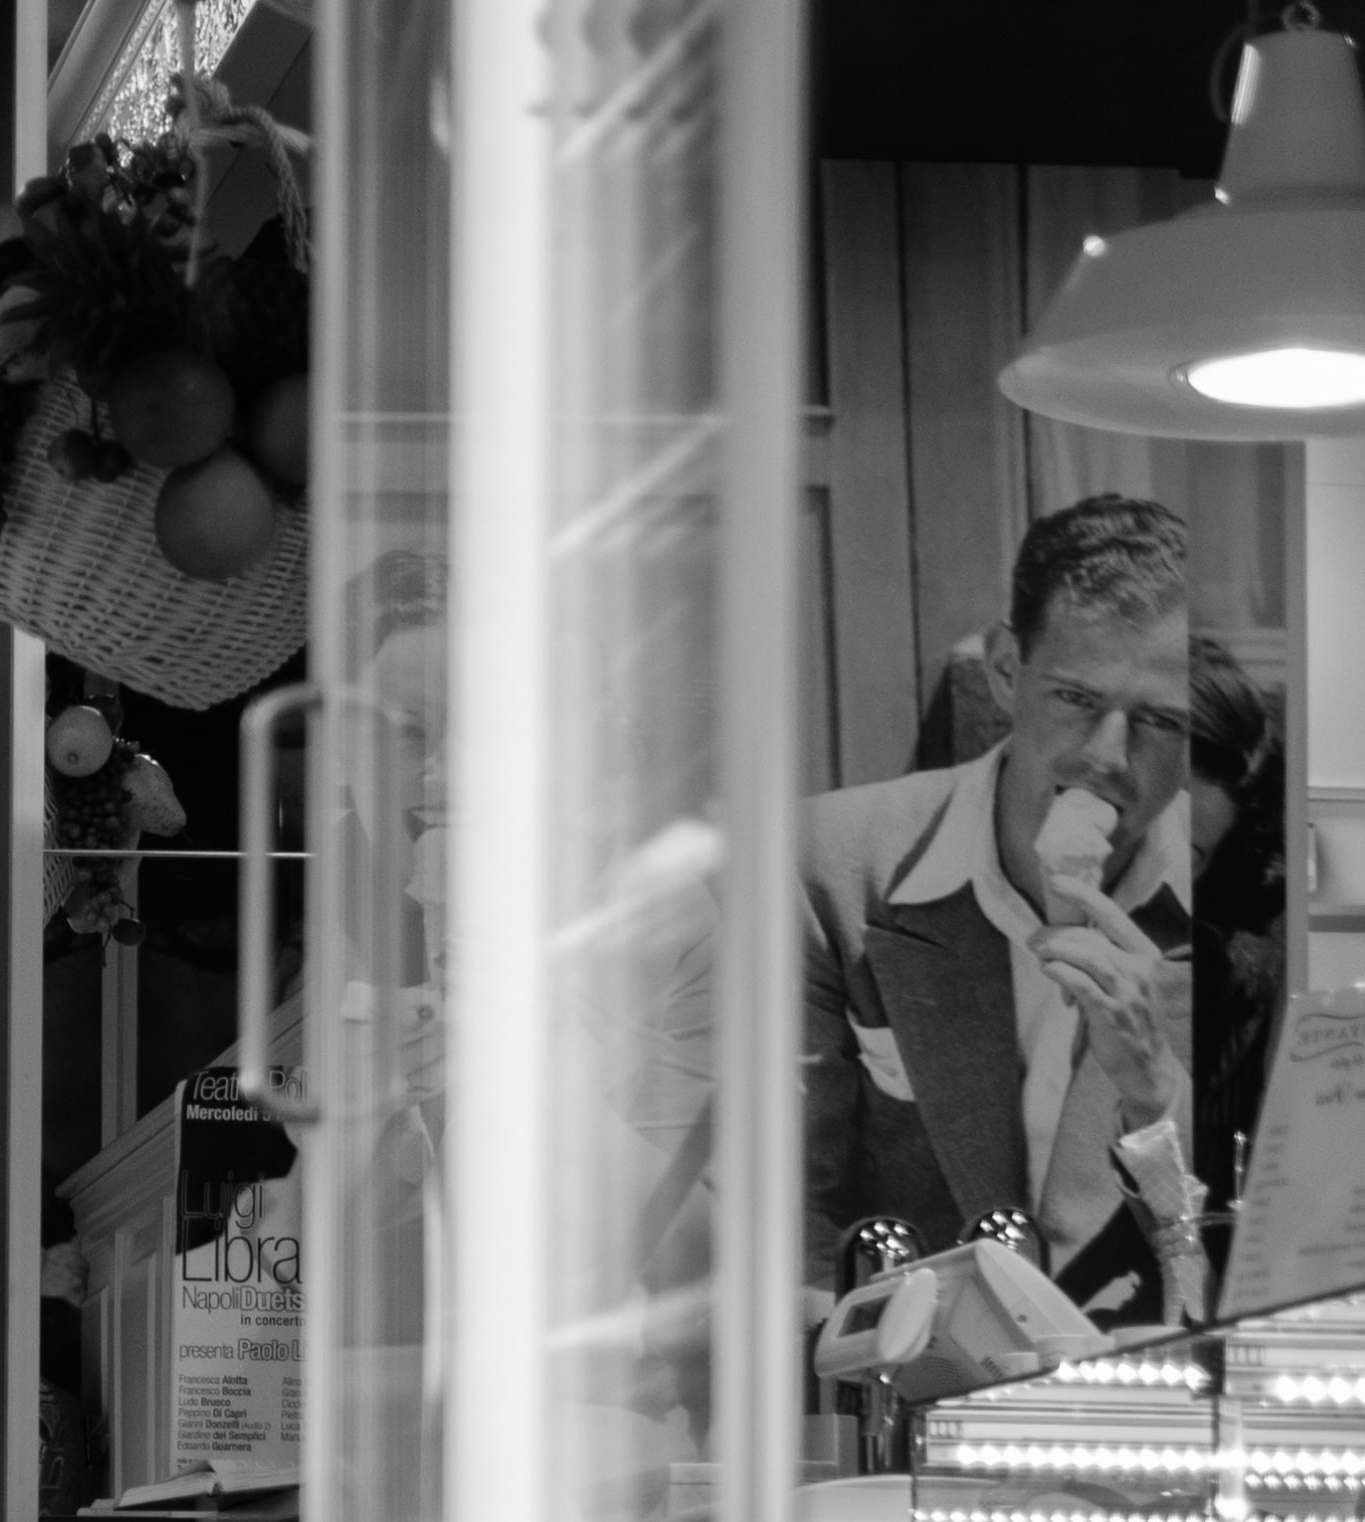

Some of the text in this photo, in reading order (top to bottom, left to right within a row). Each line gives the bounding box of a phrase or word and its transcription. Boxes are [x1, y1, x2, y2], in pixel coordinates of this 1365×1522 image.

[181, 1170, 263, 1230] Luigi
[182, 1219, 302, 1284] Libra
[240, 1314, 251, 1326] in
[179, 1343, 234, 1362] presenta
[237, 1338, 290, 1362] Paolo
